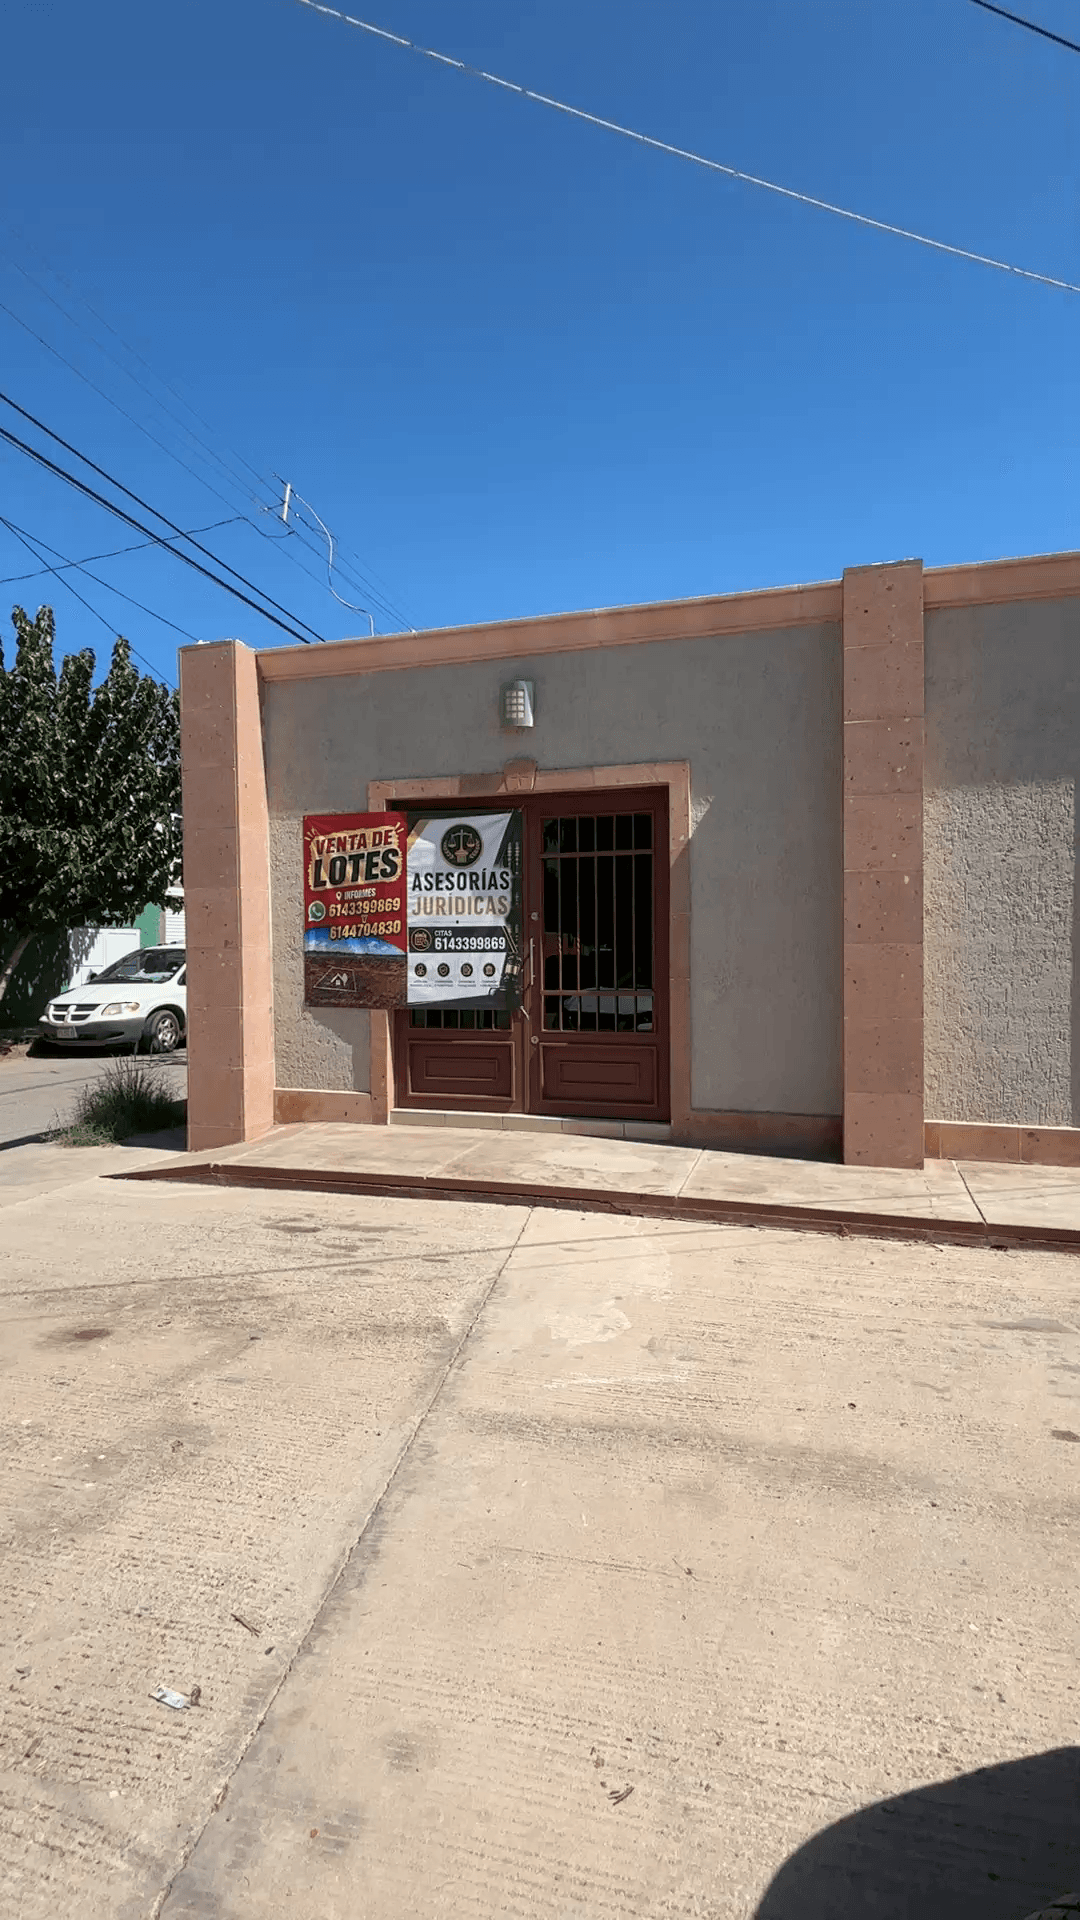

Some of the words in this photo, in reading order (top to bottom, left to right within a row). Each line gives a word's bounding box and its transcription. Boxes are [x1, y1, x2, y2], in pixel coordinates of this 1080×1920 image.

[315, 832, 367, 855] VENTA
[372, 829, 393, 847] DE
[313, 848, 399, 888] LOTES
[412, 868, 510, 891] ASESORÍAS
[344, 888, 376, 900] INFORMES
[412, 892, 508, 916] JURÍDICAS
[329, 897, 401, 917] 6143399869
[330, 920, 401, 939] 6144704830
[434, 937, 506, 950] 6143399869
